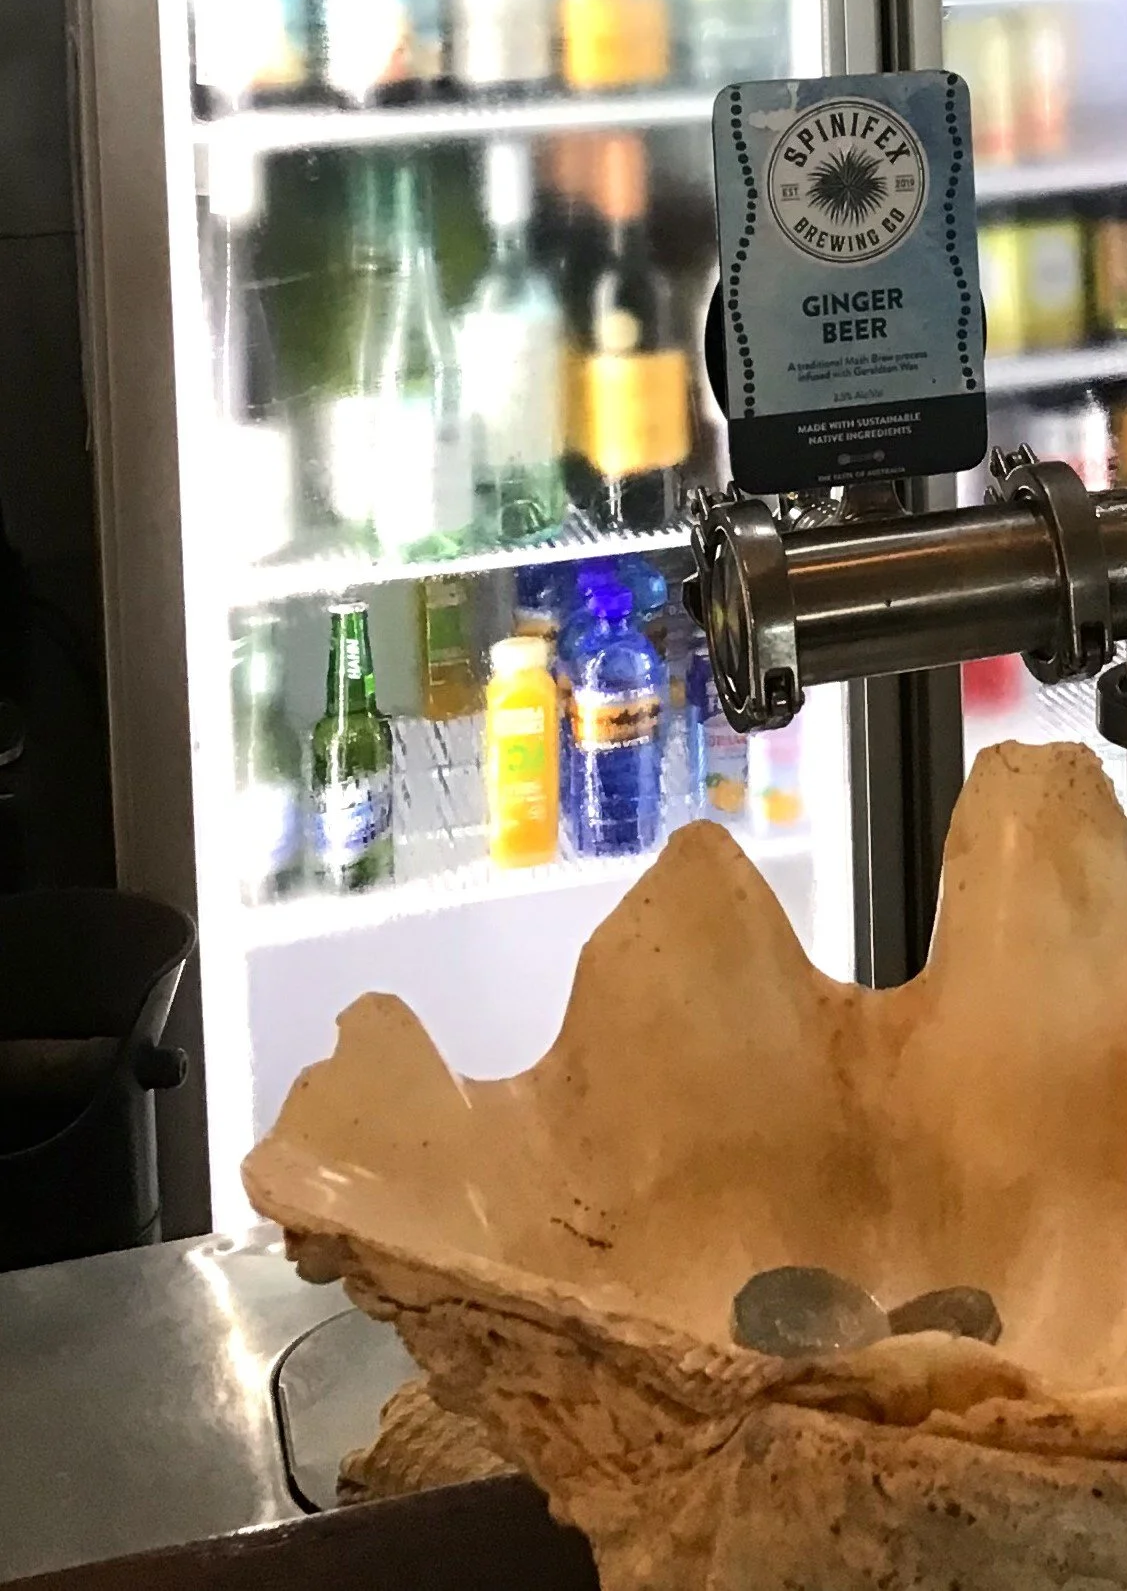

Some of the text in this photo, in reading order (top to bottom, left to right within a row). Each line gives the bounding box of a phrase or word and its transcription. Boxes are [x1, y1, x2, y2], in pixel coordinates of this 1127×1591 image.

[783, 111, 911, 168] SPINIFEX
[782, 186, 799, 198] EST
[895, 178, 915, 189] 2019
[793, 207, 906, 253] BREWING CO
[802, 287, 903, 318] GINGER
[822, 317, 888, 344] BEER
[787, 362, 796, 371] A
[797, 411, 922, 434] MADE WITH SUSTAINABLE
[808, 425, 913, 445] NATIVE INGREDIENTS
[345, 638, 362, 680] HAHN
